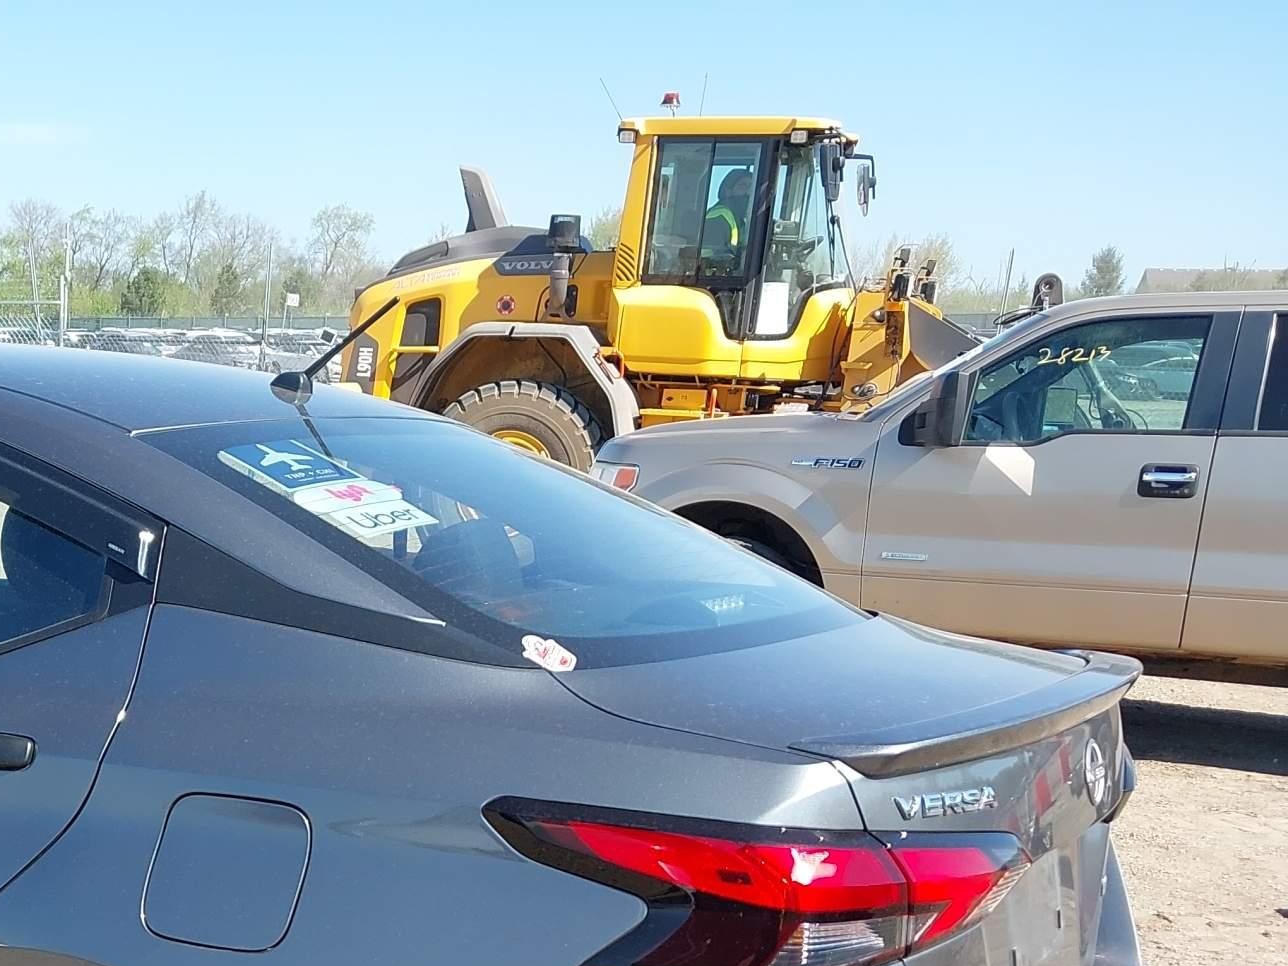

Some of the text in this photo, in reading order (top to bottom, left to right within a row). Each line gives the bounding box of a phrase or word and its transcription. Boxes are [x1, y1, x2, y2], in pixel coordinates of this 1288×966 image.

[500, 260, 554, 271] VOLV
[356, 347, 374, 378] L90H
[1037, 345, 1112, 365] 28213
[347, 508, 420, 529] Uber
[892, 785, 999, 821] VERSA
